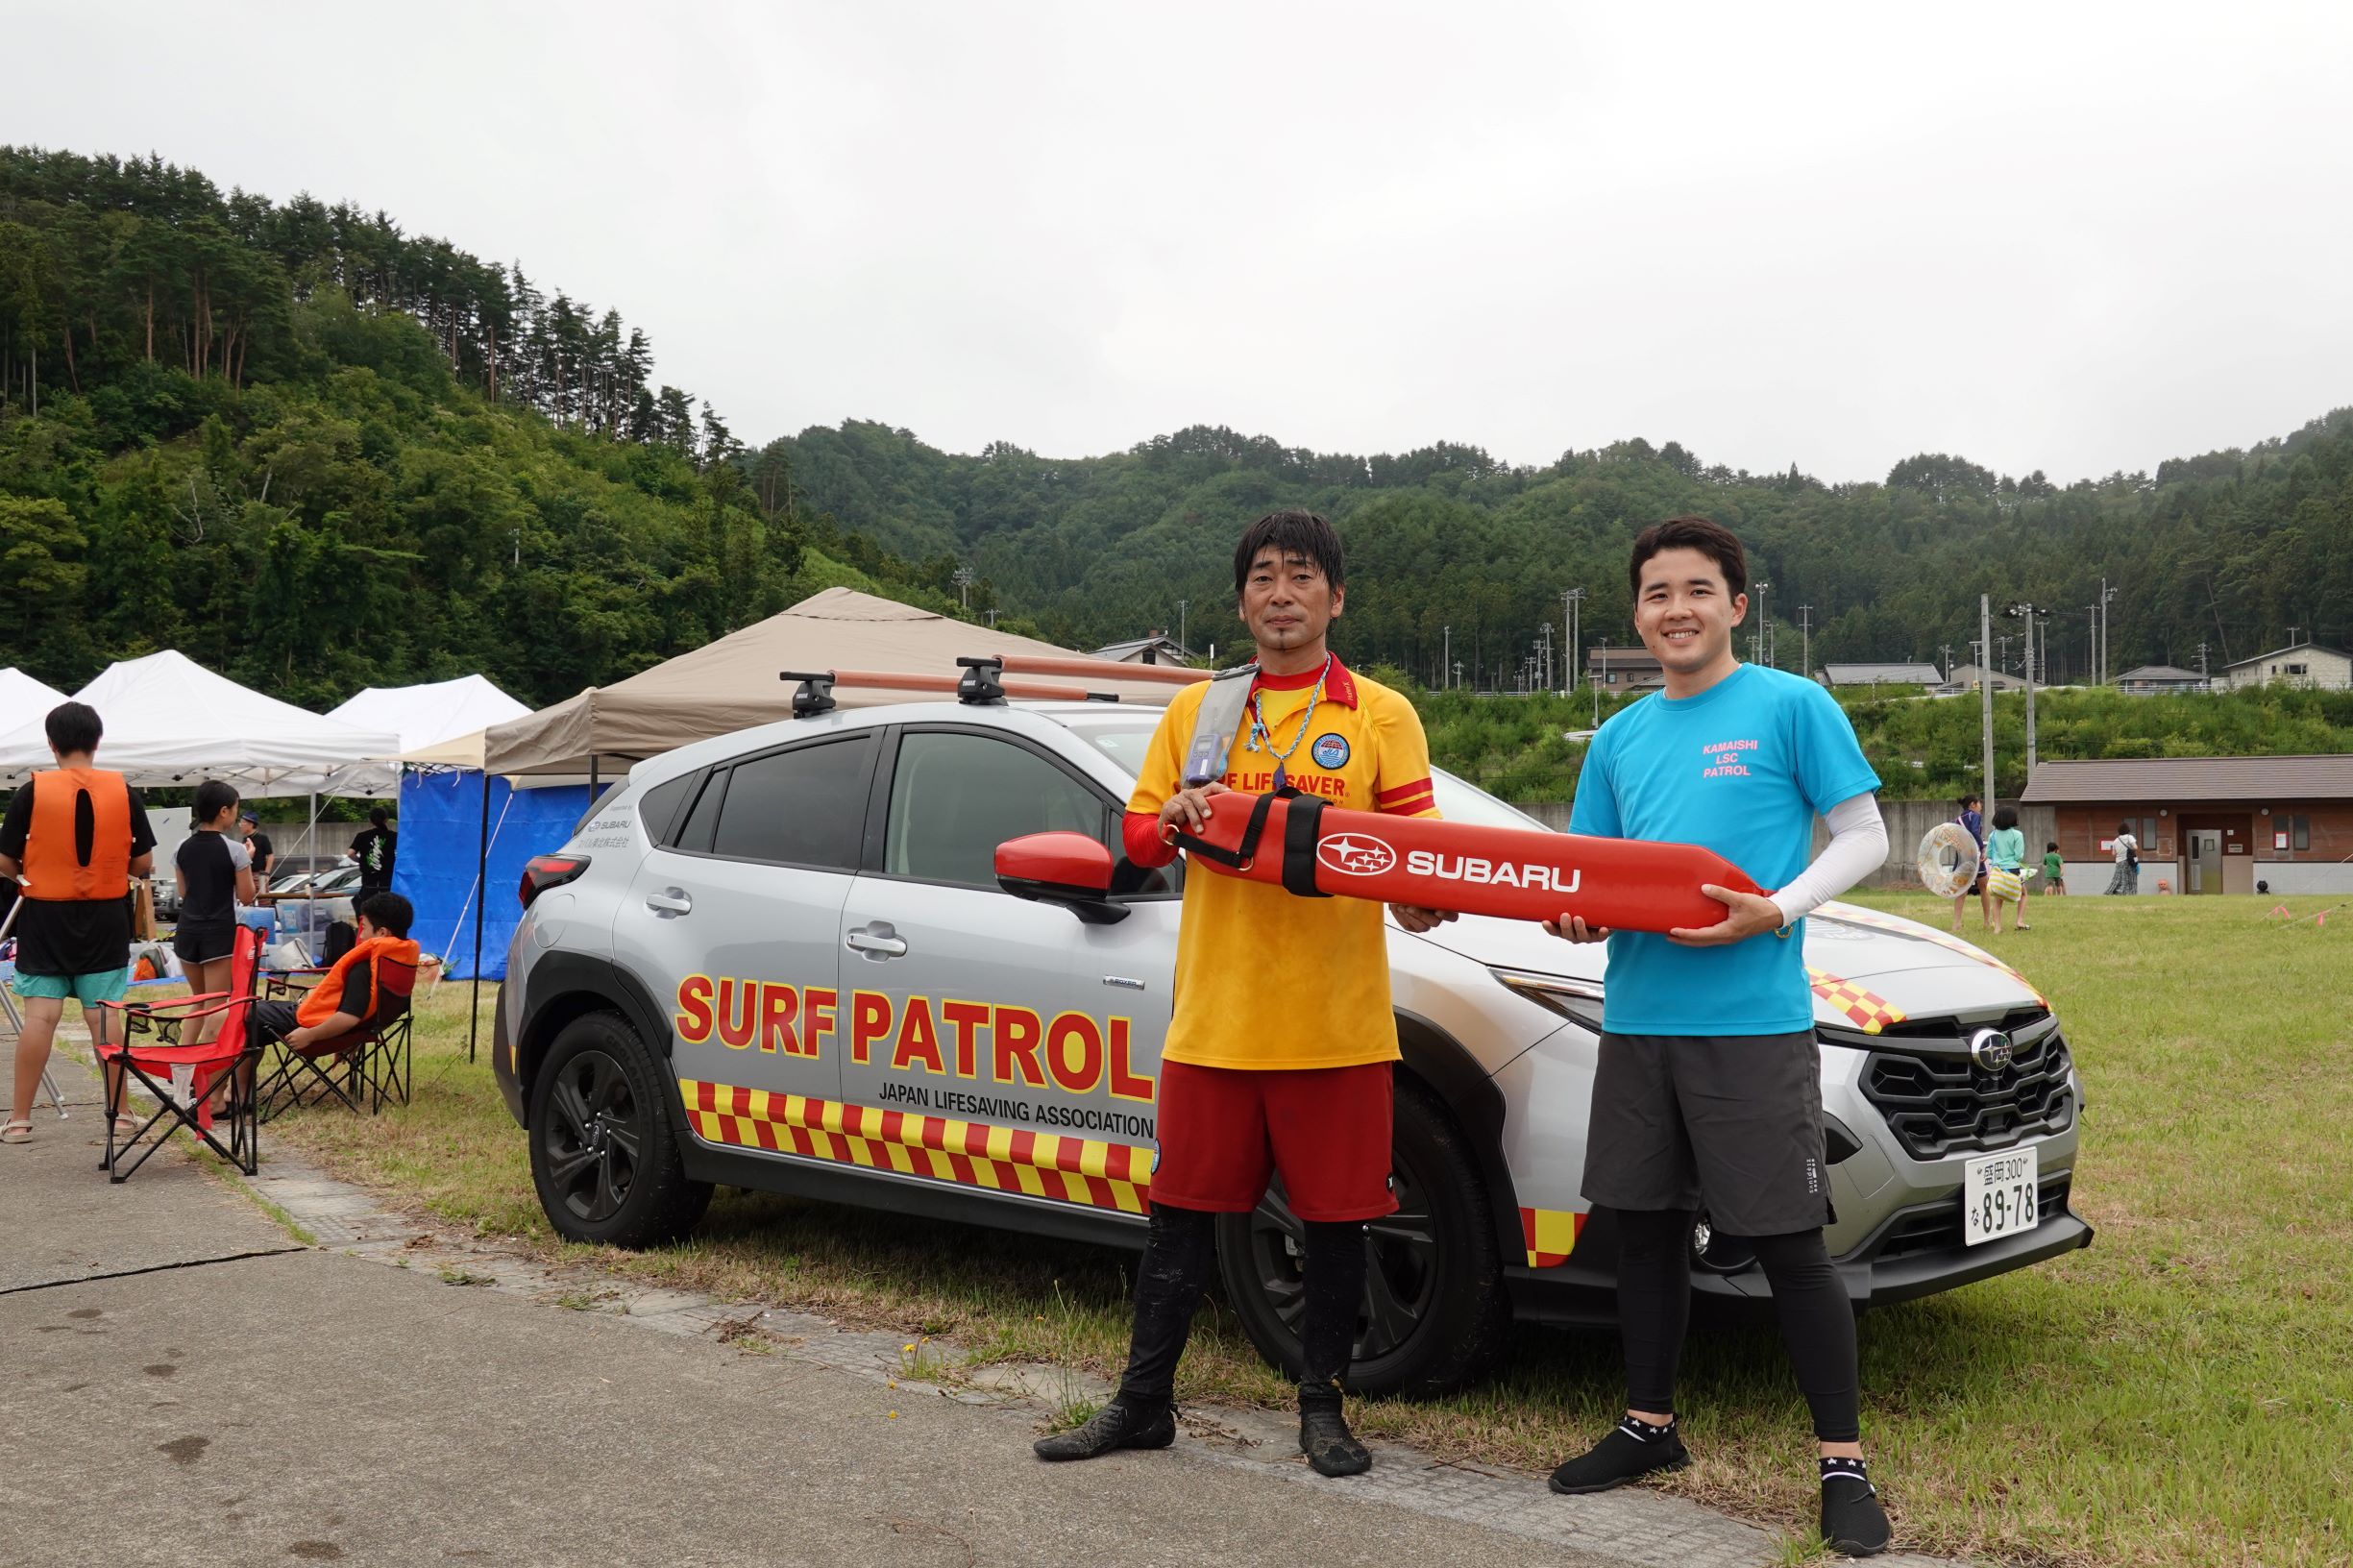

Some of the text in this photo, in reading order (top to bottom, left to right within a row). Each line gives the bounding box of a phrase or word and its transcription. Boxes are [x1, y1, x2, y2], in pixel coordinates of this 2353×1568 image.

[1703, 739, 1758, 755] KAMAISHI
[1715, 752, 1738, 765] LSC
[1703, 765, 1752, 778] PATROL
[601, 820, 632, 830] SUBARU
[1407, 849, 1581, 894] SUBARU
[674, 972, 1156, 1105] SURF PATROL
[878, 1082, 1154, 1139] JAPAN LIFESAVING ASSOCIATION
[1982, 1182, 2034, 1234] 89-78
